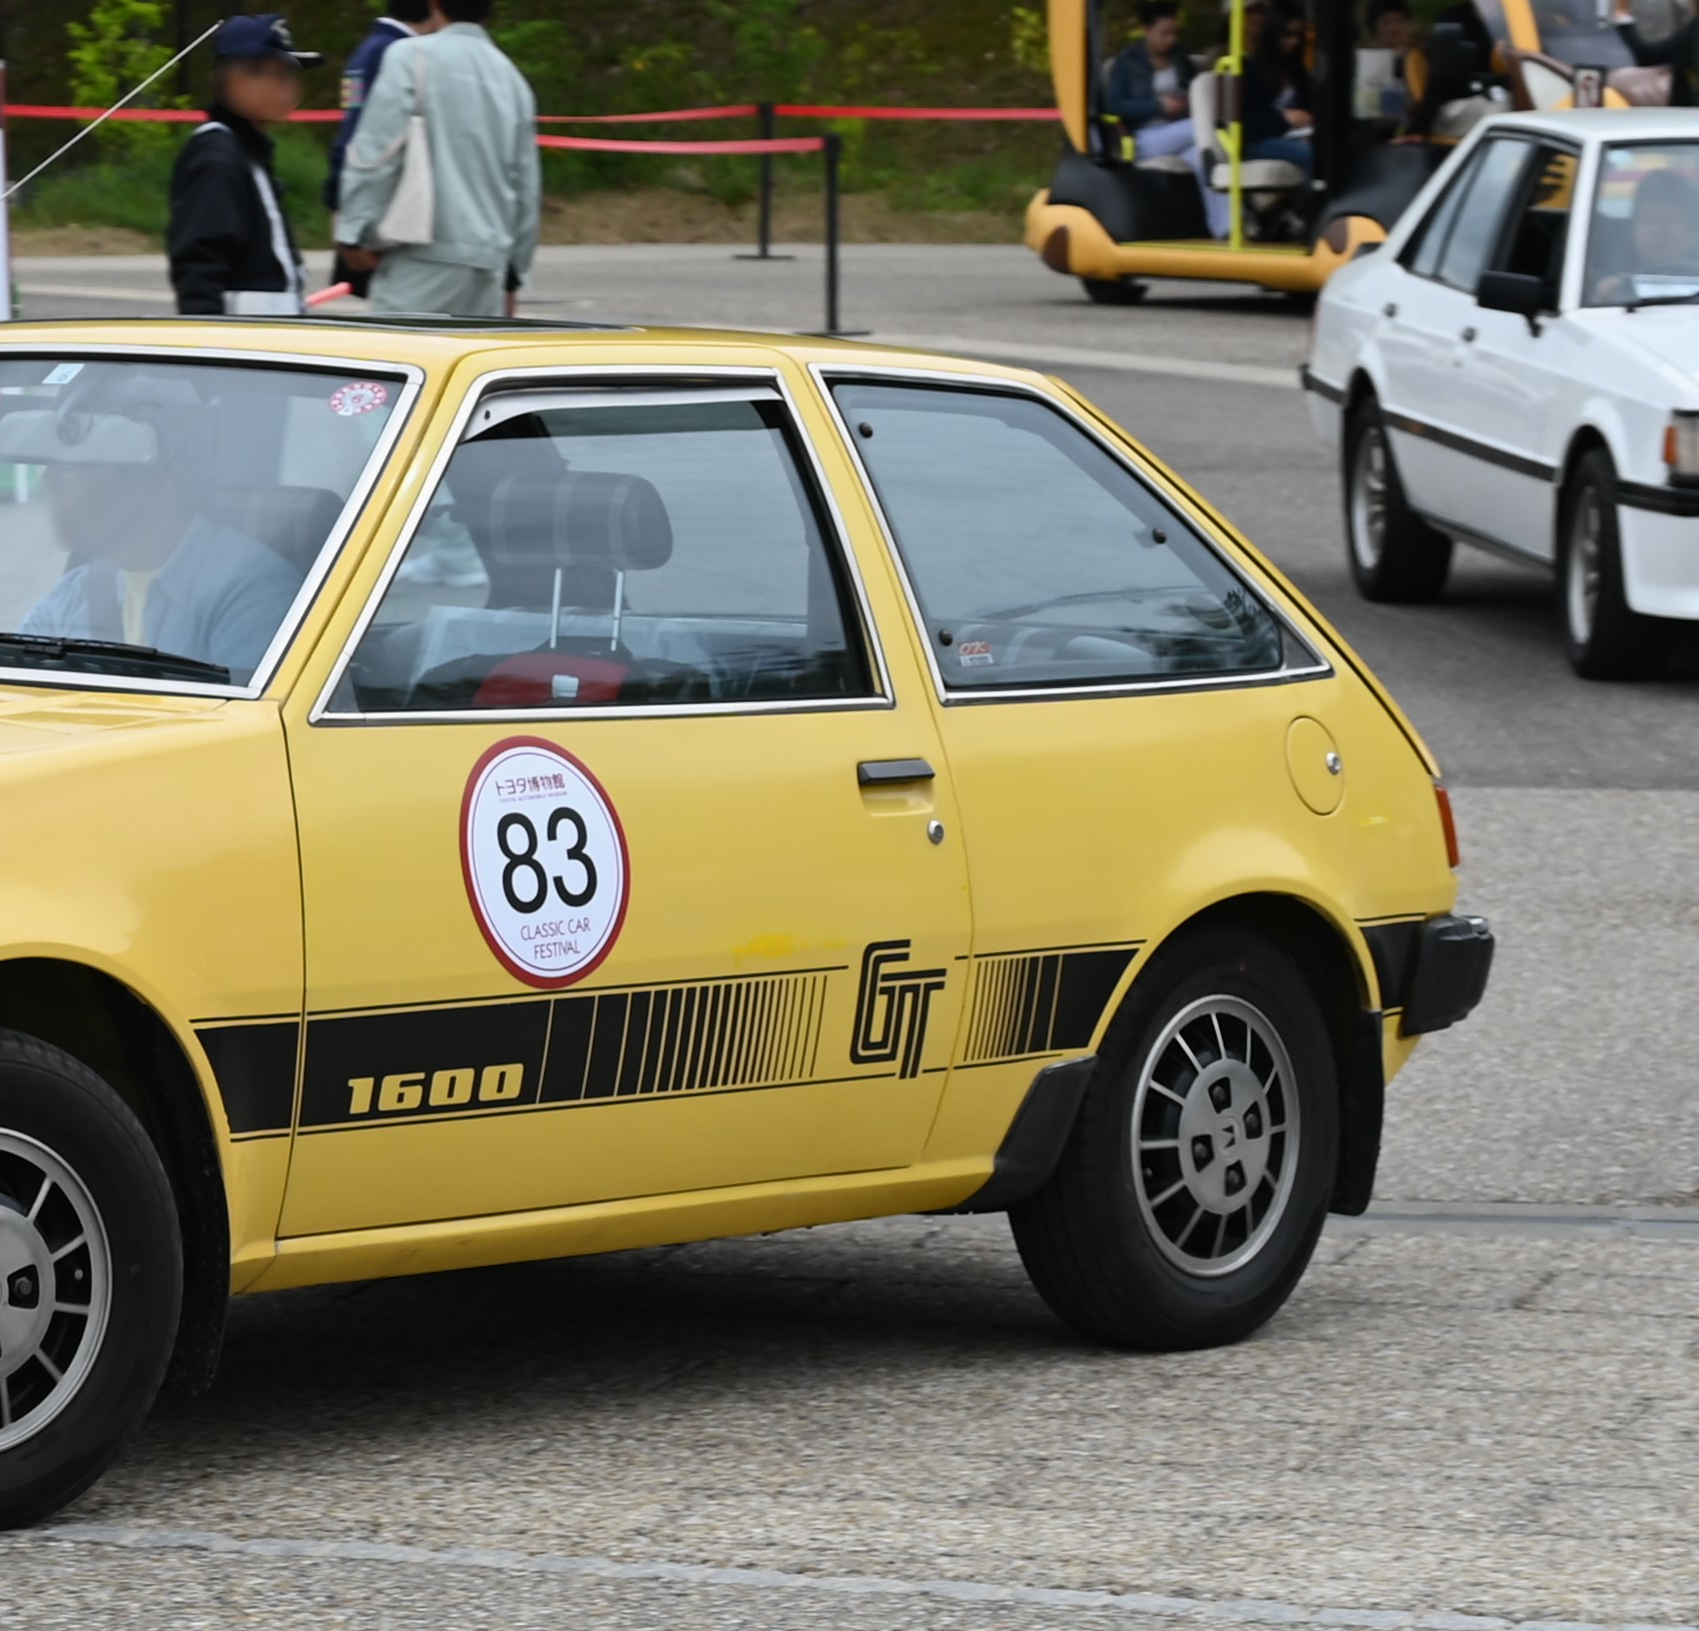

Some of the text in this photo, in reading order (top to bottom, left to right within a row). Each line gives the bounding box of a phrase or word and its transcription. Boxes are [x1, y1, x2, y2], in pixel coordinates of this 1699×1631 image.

[495, 773, 566, 797] トヨタ博物館
[497, 806, 598, 914] 83
[520, 917, 591, 941] CLASSIC CAR
[534, 939, 581, 960] FESTIVAL
[850, 939, 947, 1079] GT
[348, 1062, 525, 1116] 1600
